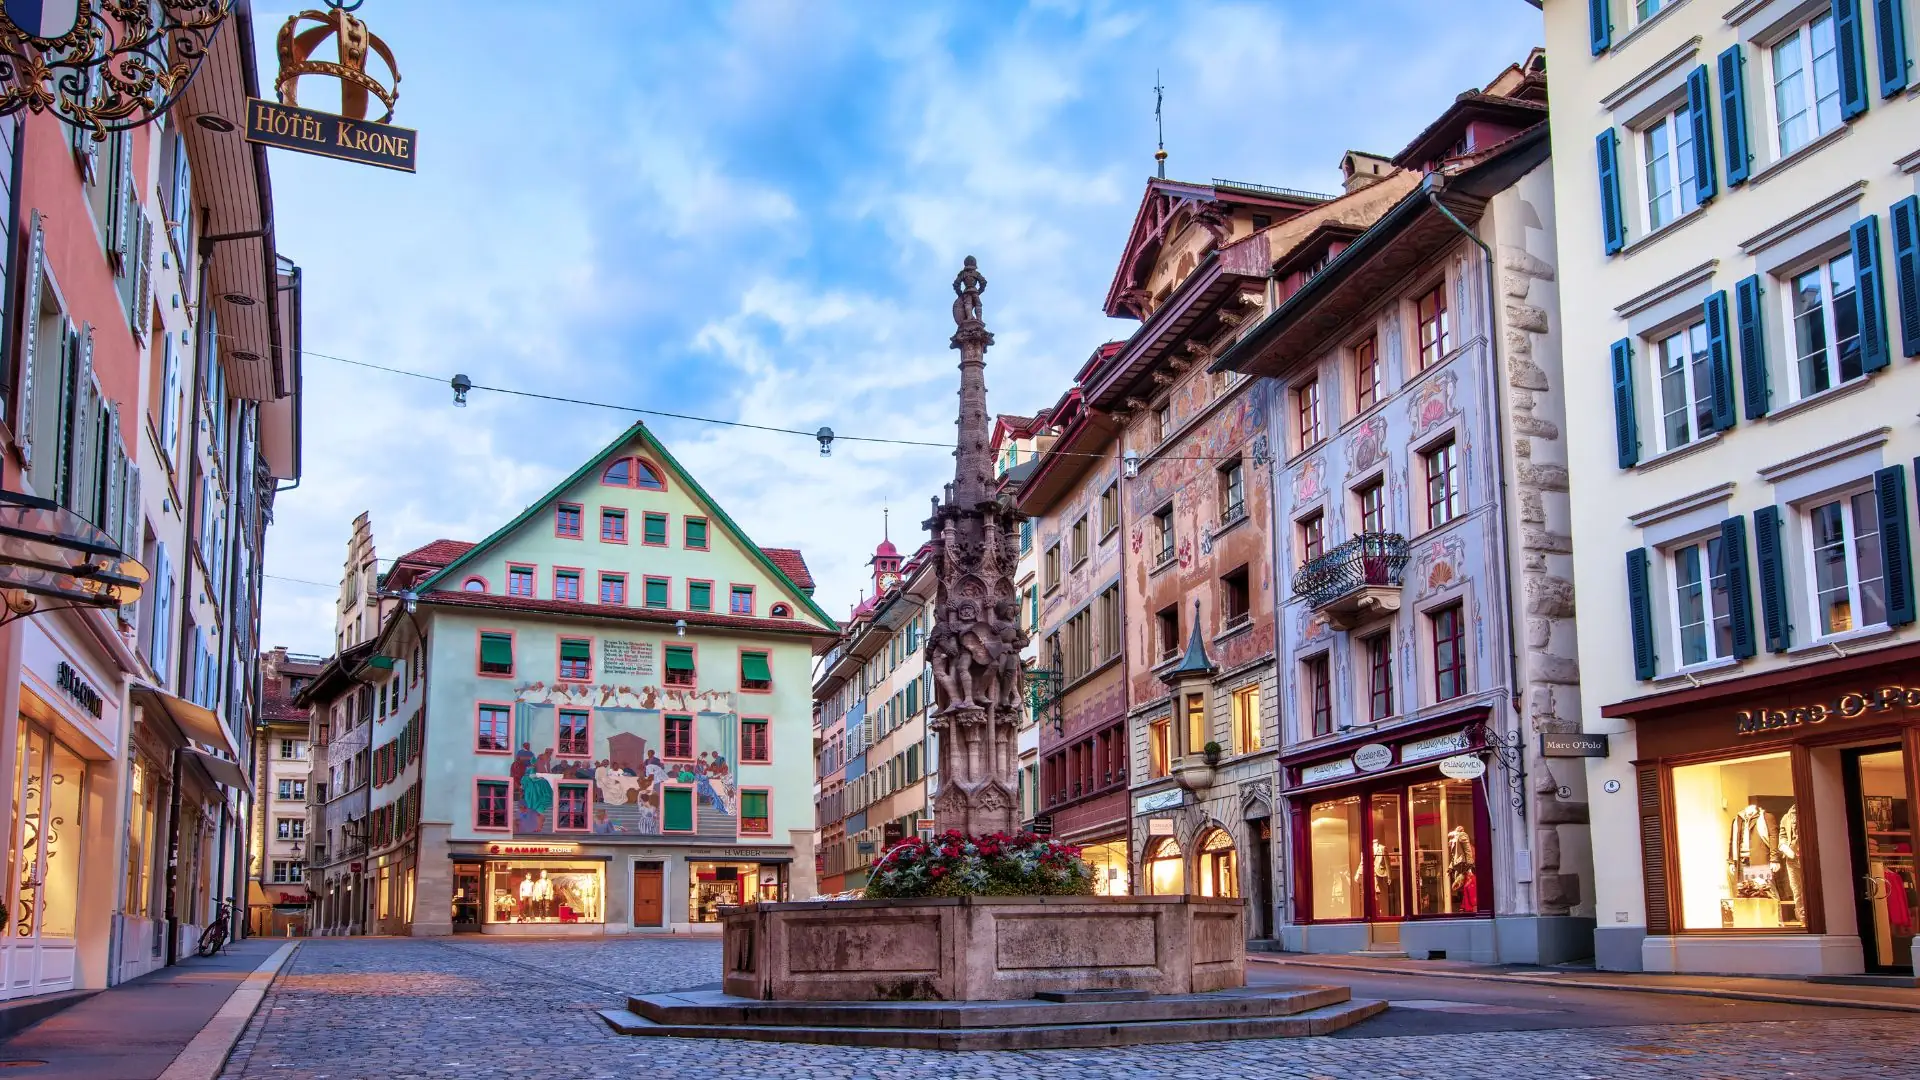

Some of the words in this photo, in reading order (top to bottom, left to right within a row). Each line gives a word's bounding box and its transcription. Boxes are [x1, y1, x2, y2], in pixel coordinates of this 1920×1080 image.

[336, 121, 409, 159] KRONE
[1736, 704, 1827, 735] Marc
[1546, 741, 1570, 749] Marc
[1572, 741, 1602, 749] O'Polo
[733, 849, 761, 857] WEBER
